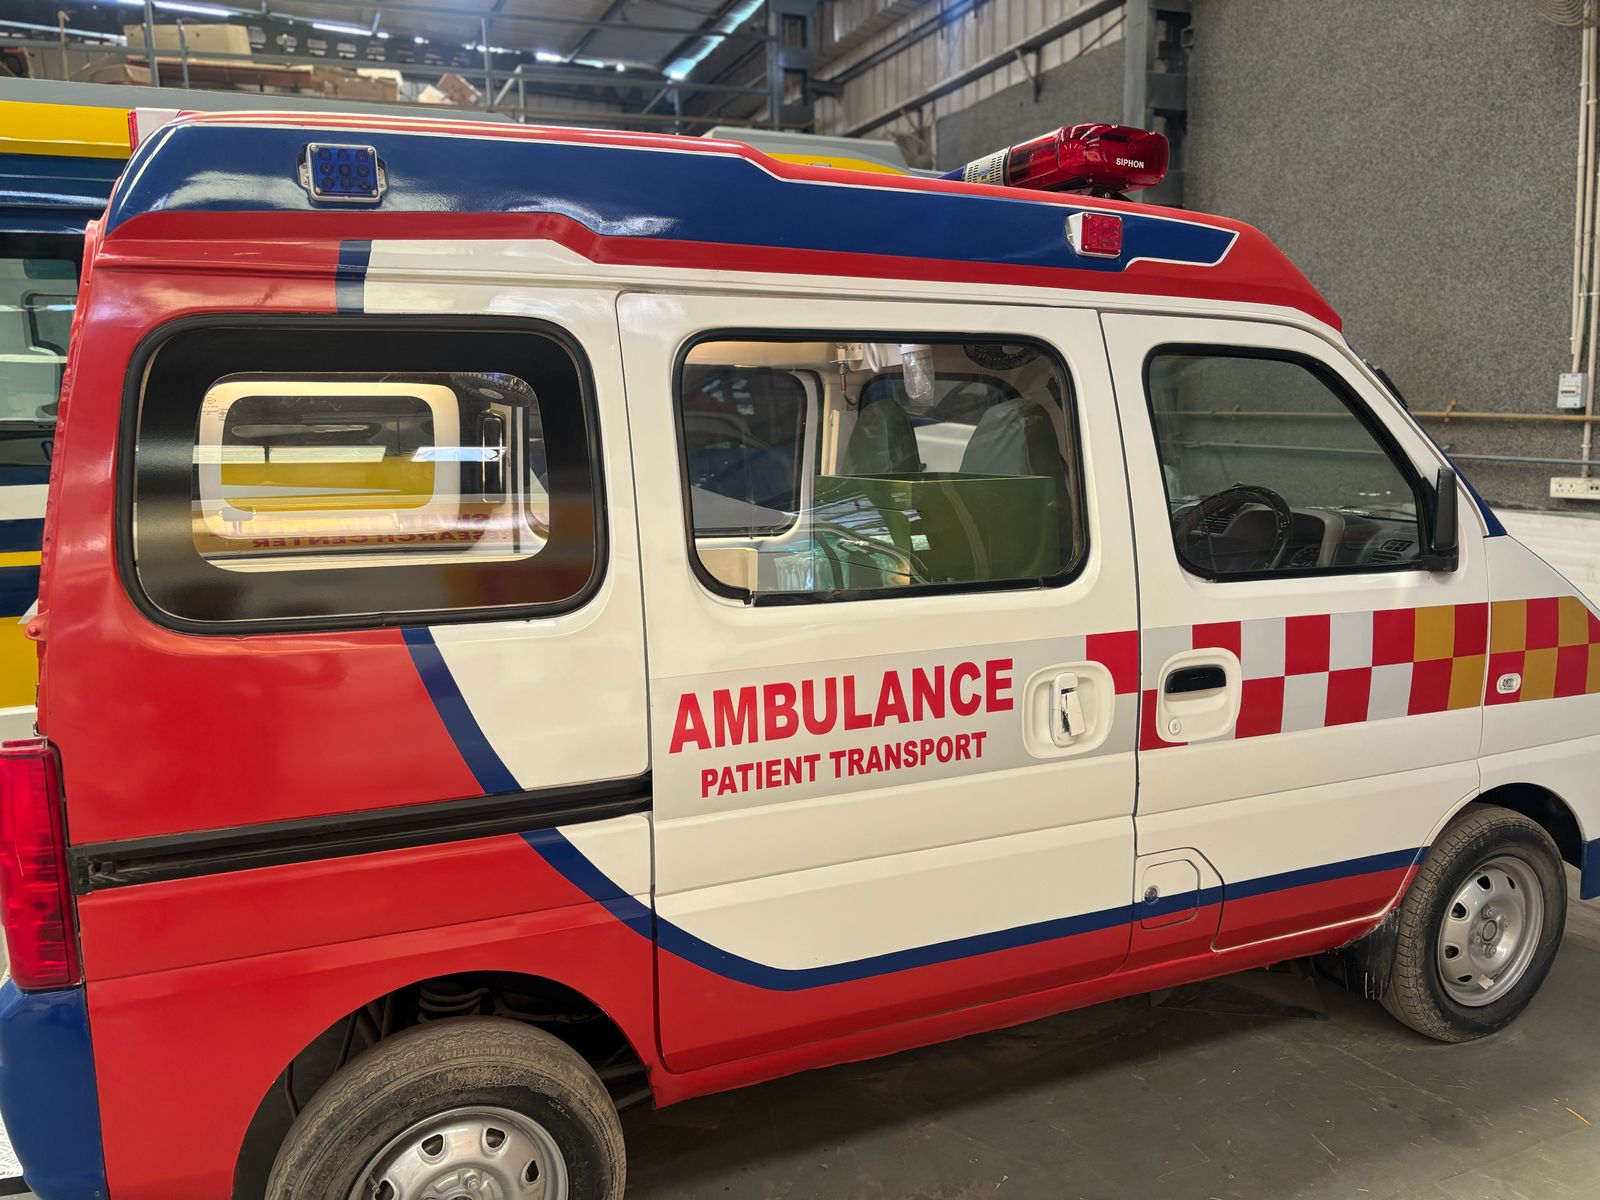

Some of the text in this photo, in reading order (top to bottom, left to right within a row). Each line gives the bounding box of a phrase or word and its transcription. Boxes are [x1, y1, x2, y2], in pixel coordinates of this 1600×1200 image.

[1116, 157, 1145, 169] SIPHON
[668, 658, 1014, 754] AMBULANCE
[701, 731, 988, 798] PATIENT TRANSPORT
